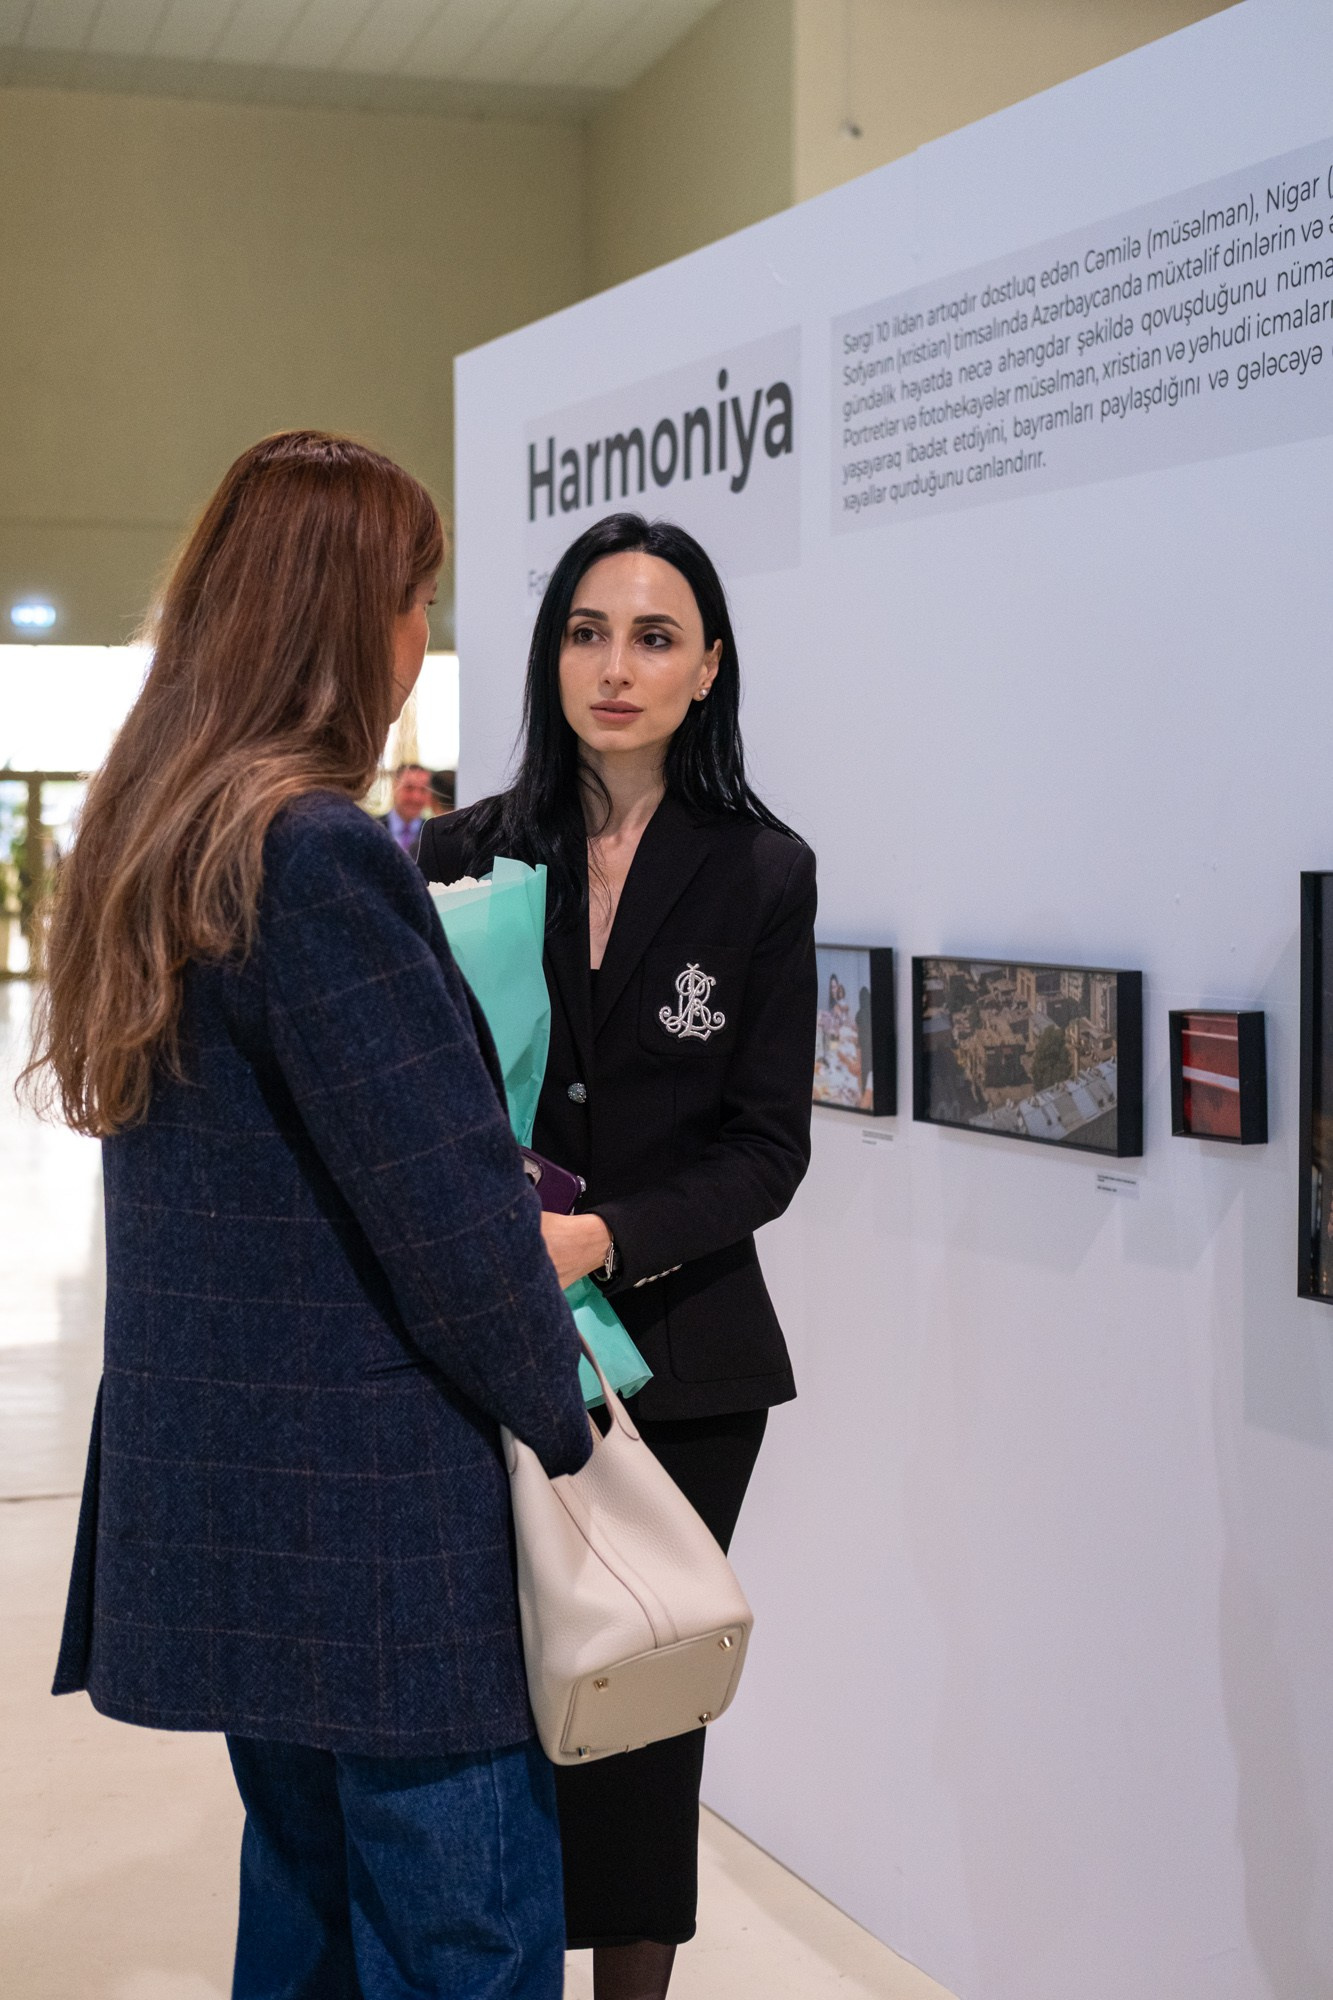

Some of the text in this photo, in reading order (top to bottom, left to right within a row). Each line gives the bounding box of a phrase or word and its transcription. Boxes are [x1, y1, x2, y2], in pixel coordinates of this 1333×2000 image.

[842, 356, 895, 387] Sofyanın
[896, 331, 951, 374] (xristian)
[954, 311, 1028, 352] timsalında
[1031, 273, 1142, 328] Azərbaycanda
[1147, 244, 1220, 292] müxtəlif
[1223, 224, 1295, 267] dinlərin
[1301, 218, 1324, 243] və
[843, 325, 873, 355] Sərgi
[876, 320, 890, 343] 10
[892, 313, 924, 338] ildən
[927, 292, 977, 326] artıqdır
[981, 275, 1036, 308] dostluq
[1040, 261, 1079, 289] edən
[1084, 236, 1141, 274] Cəmilə
[1147, 193, 1259, 259] (müsəlman),
[1267, 176, 1320, 214] Nigar
[842, 384, 896, 422] gündəlik
[901, 367, 953, 402] həyatda
[958, 359, 993, 384] necə
[998, 334, 1070, 373] ahəngdar
[1077, 314, 1134, 356] şəkildə
[1141, 277, 1267, 336] qovuşduğunu
[843, 416, 900, 449] Portretlər
[902, 413, 917, 433] və
[918, 387, 1011, 428] fotohekayələr
[1014, 366, 1100, 401] müsəlman,
[1102, 346, 1161, 381] xristian
[1165, 341, 1185, 363] və
[1188, 316, 1251, 363] yəhudi
[906, 436, 948, 464] ibadət
[953, 419, 1007, 453] etdiyini,
[1013, 402, 1094, 440] bayramları
[1101, 375, 1200, 423] paylaşdığını
[1208, 368, 1229, 390] və
[1237, 344, 1323, 390] gələcəyə
[527, 367, 794, 523] Harmoniya
[889, 468, 963, 504] qurduğunu
[967, 448, 1047, 484] canlandırır.
